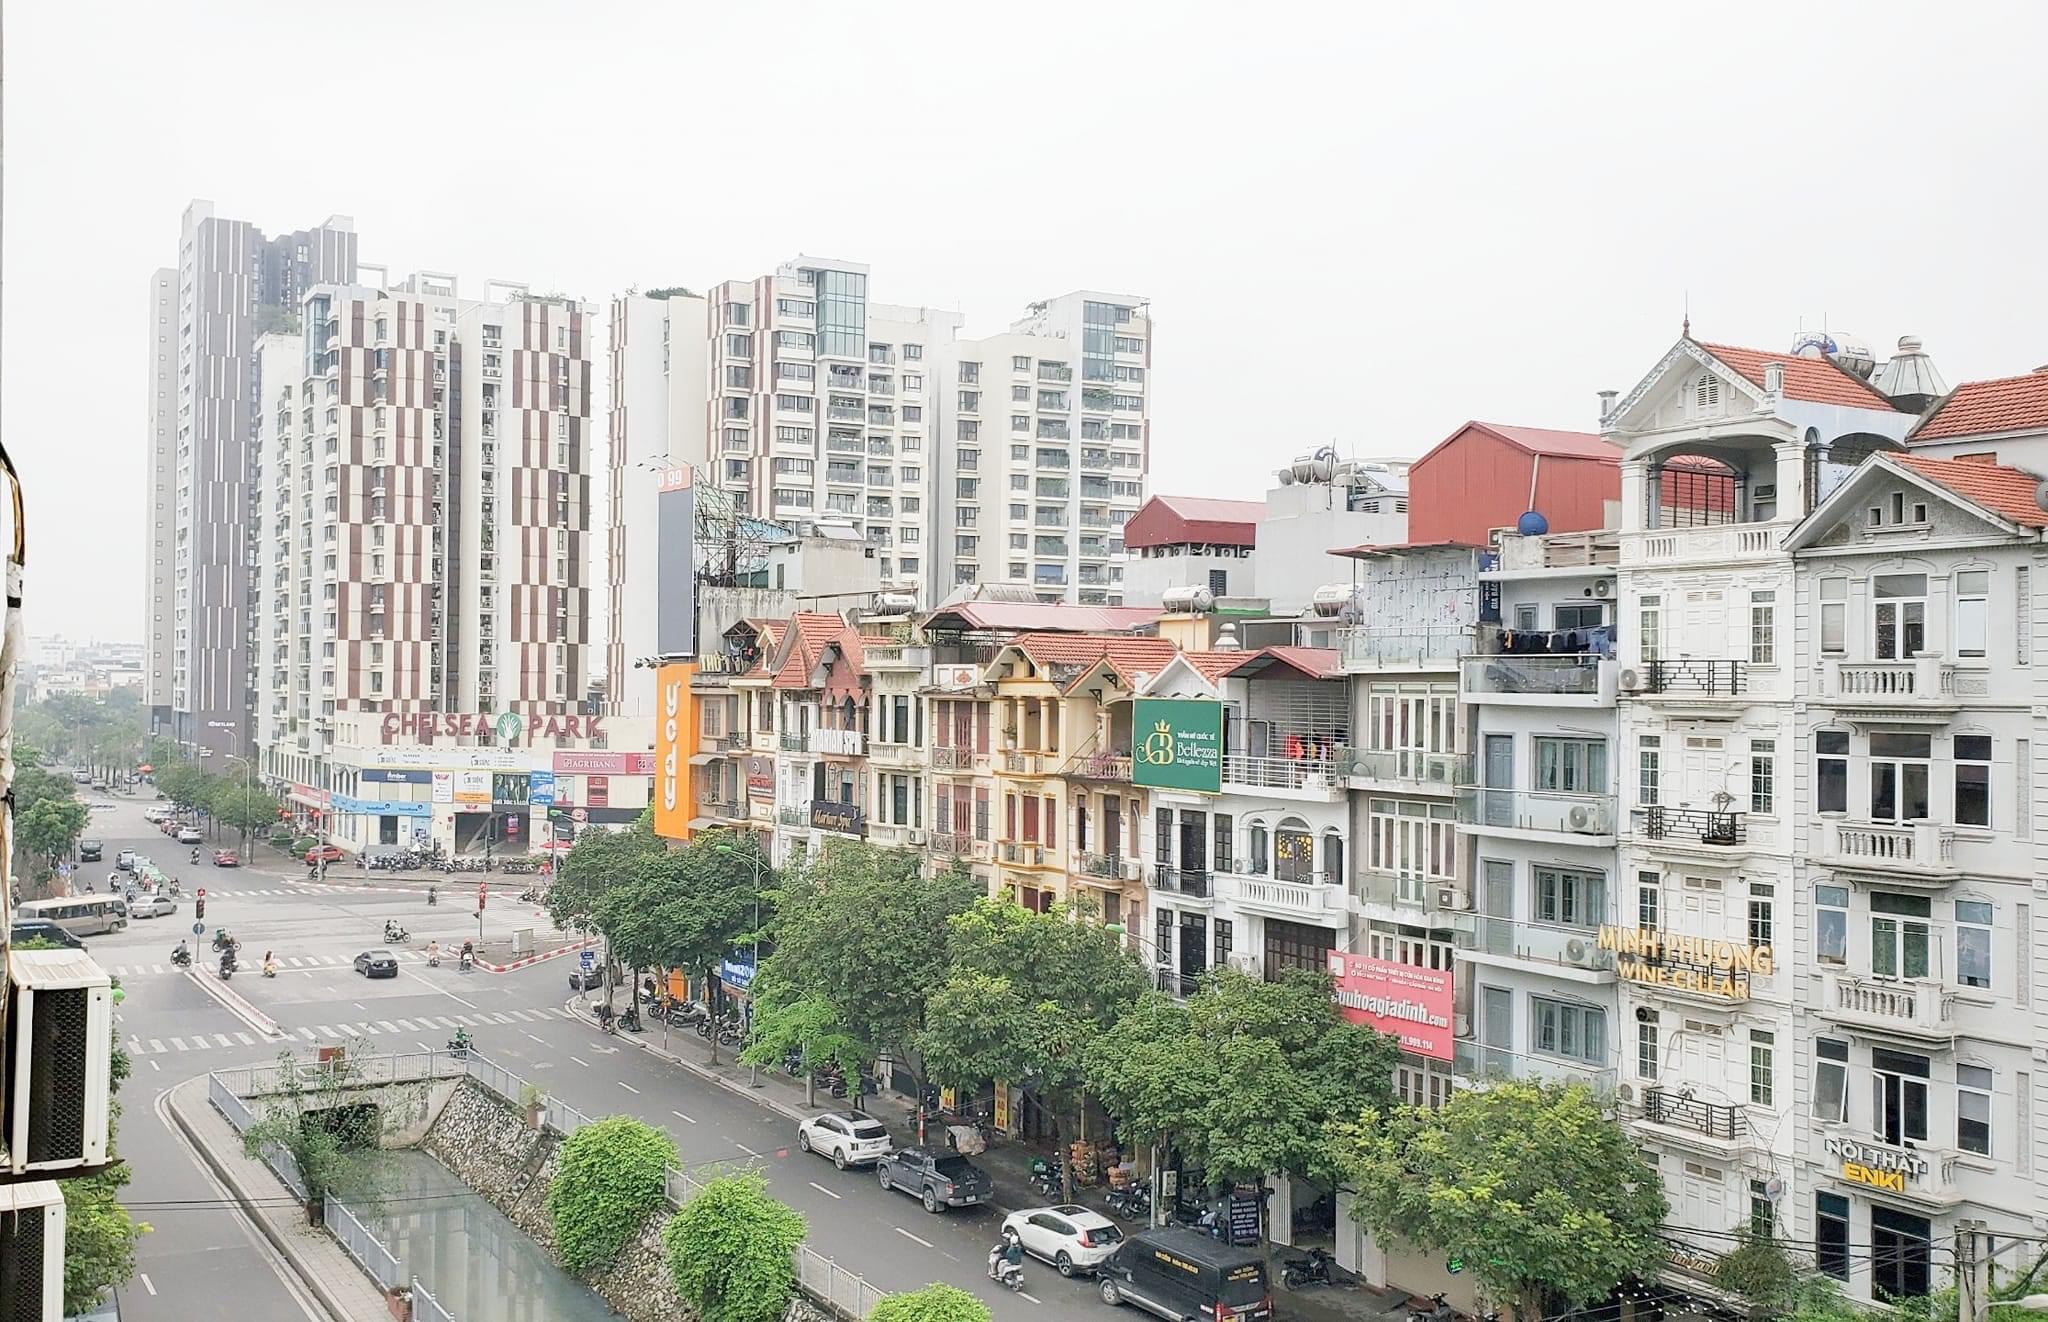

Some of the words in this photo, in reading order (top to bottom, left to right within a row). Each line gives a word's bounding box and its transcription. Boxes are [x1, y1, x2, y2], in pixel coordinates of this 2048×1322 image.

[382, 712, 490, 736] CHELSEA
[528, 713, 604, 738] PARK
[1177, 741, 1217, 759] Bellezza
[1599, 923, 1659, 957] MINH
[1617, 961, 1668, 985] WINE
[1673, 970, 1748, 999] CELLAR
[1825, 1138, 1863, 1162] NỘI
[1869, 1150, 1922, 1174] THẤT
